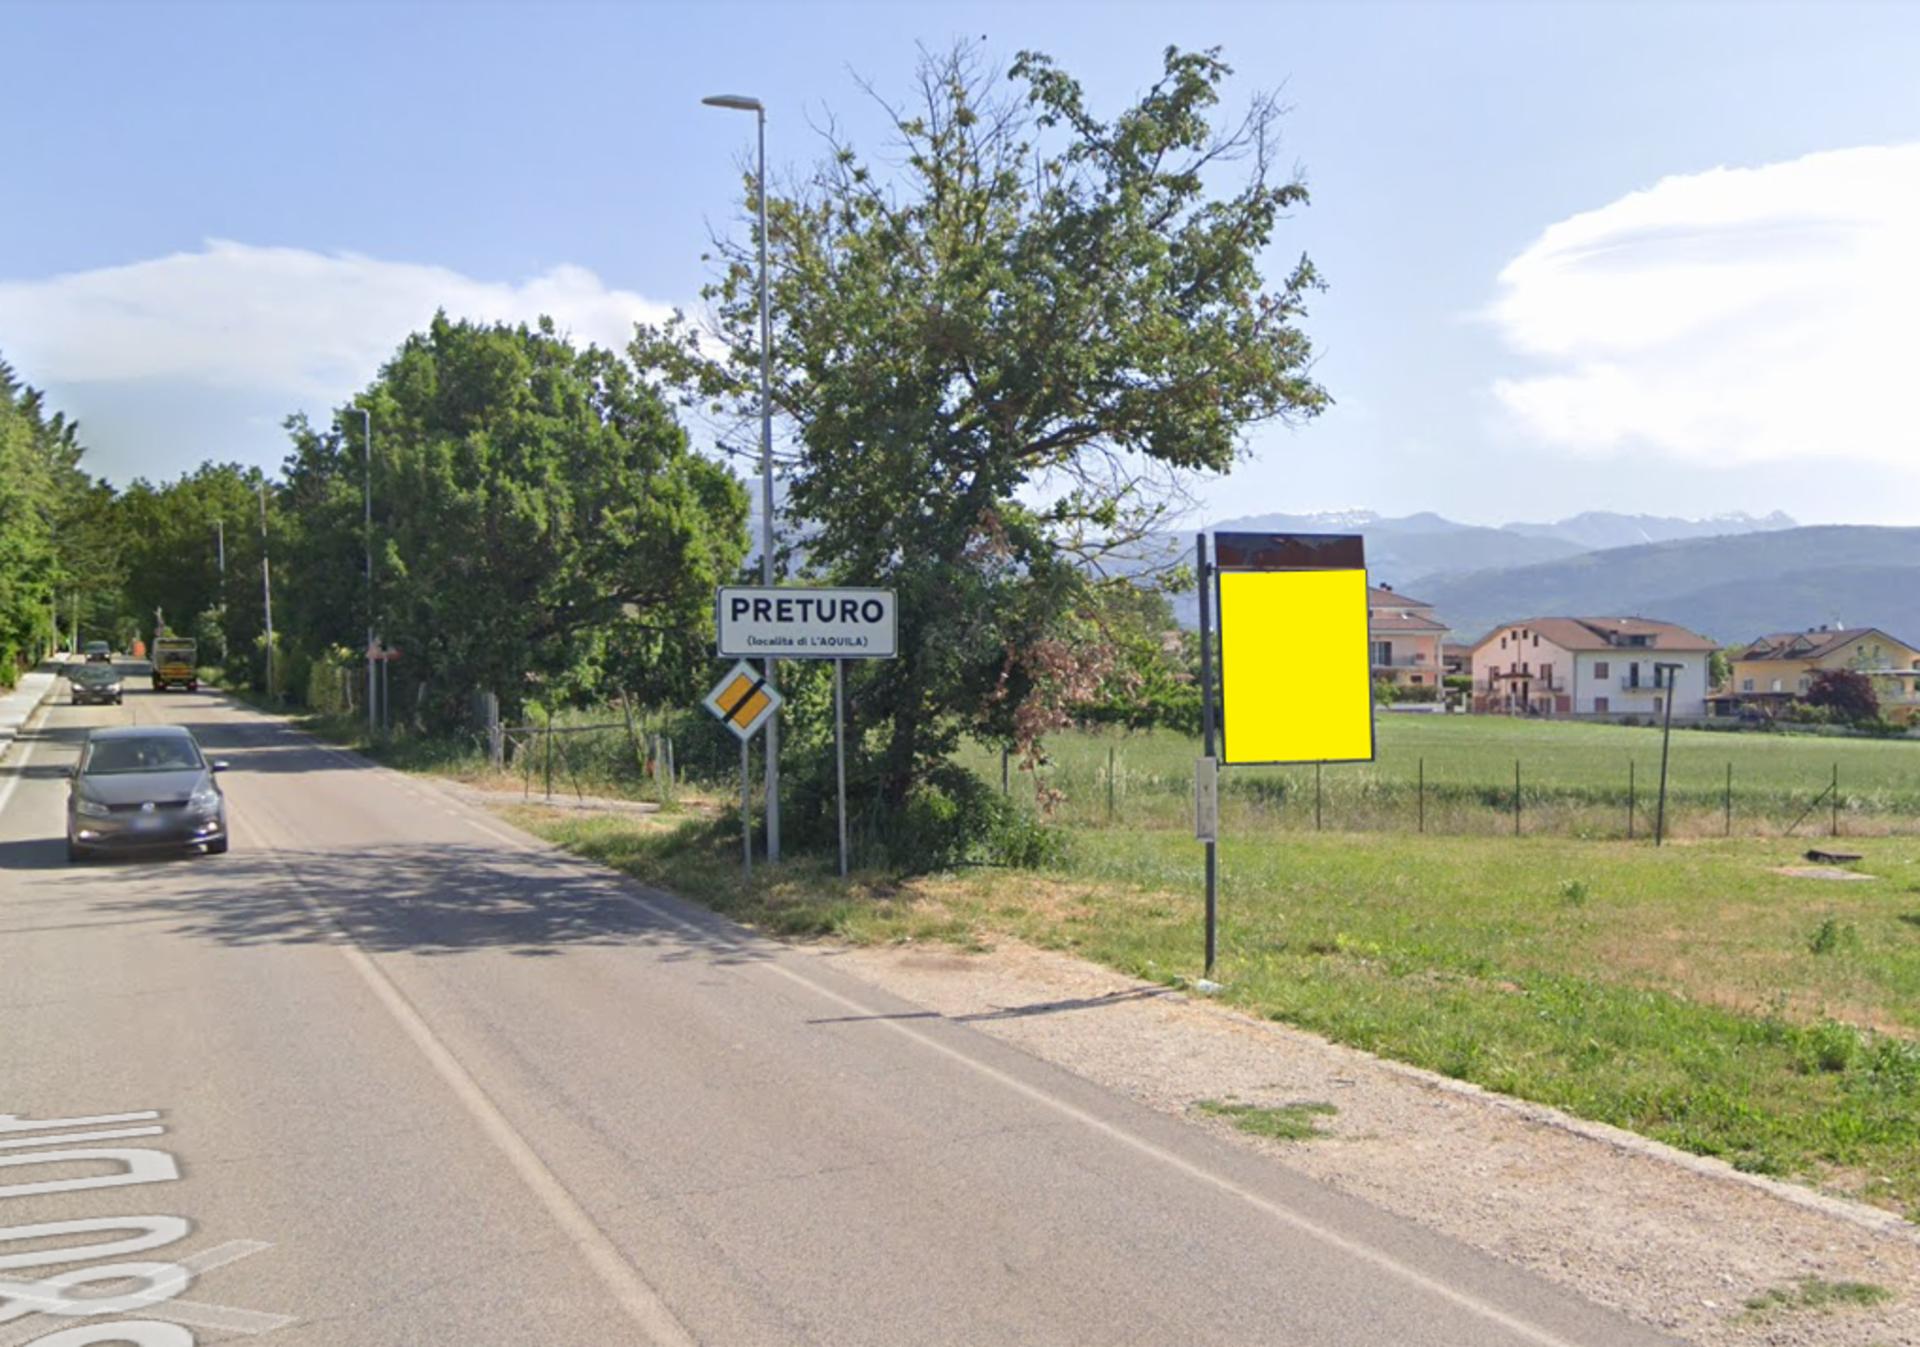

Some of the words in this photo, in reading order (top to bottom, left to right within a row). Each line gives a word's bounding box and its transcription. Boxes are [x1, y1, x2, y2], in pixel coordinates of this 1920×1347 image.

[731, 598, 884, 623] PRETURO
[797, 635, 808, 646] di
[811, 635, 868, 648] L'AQUILA)
